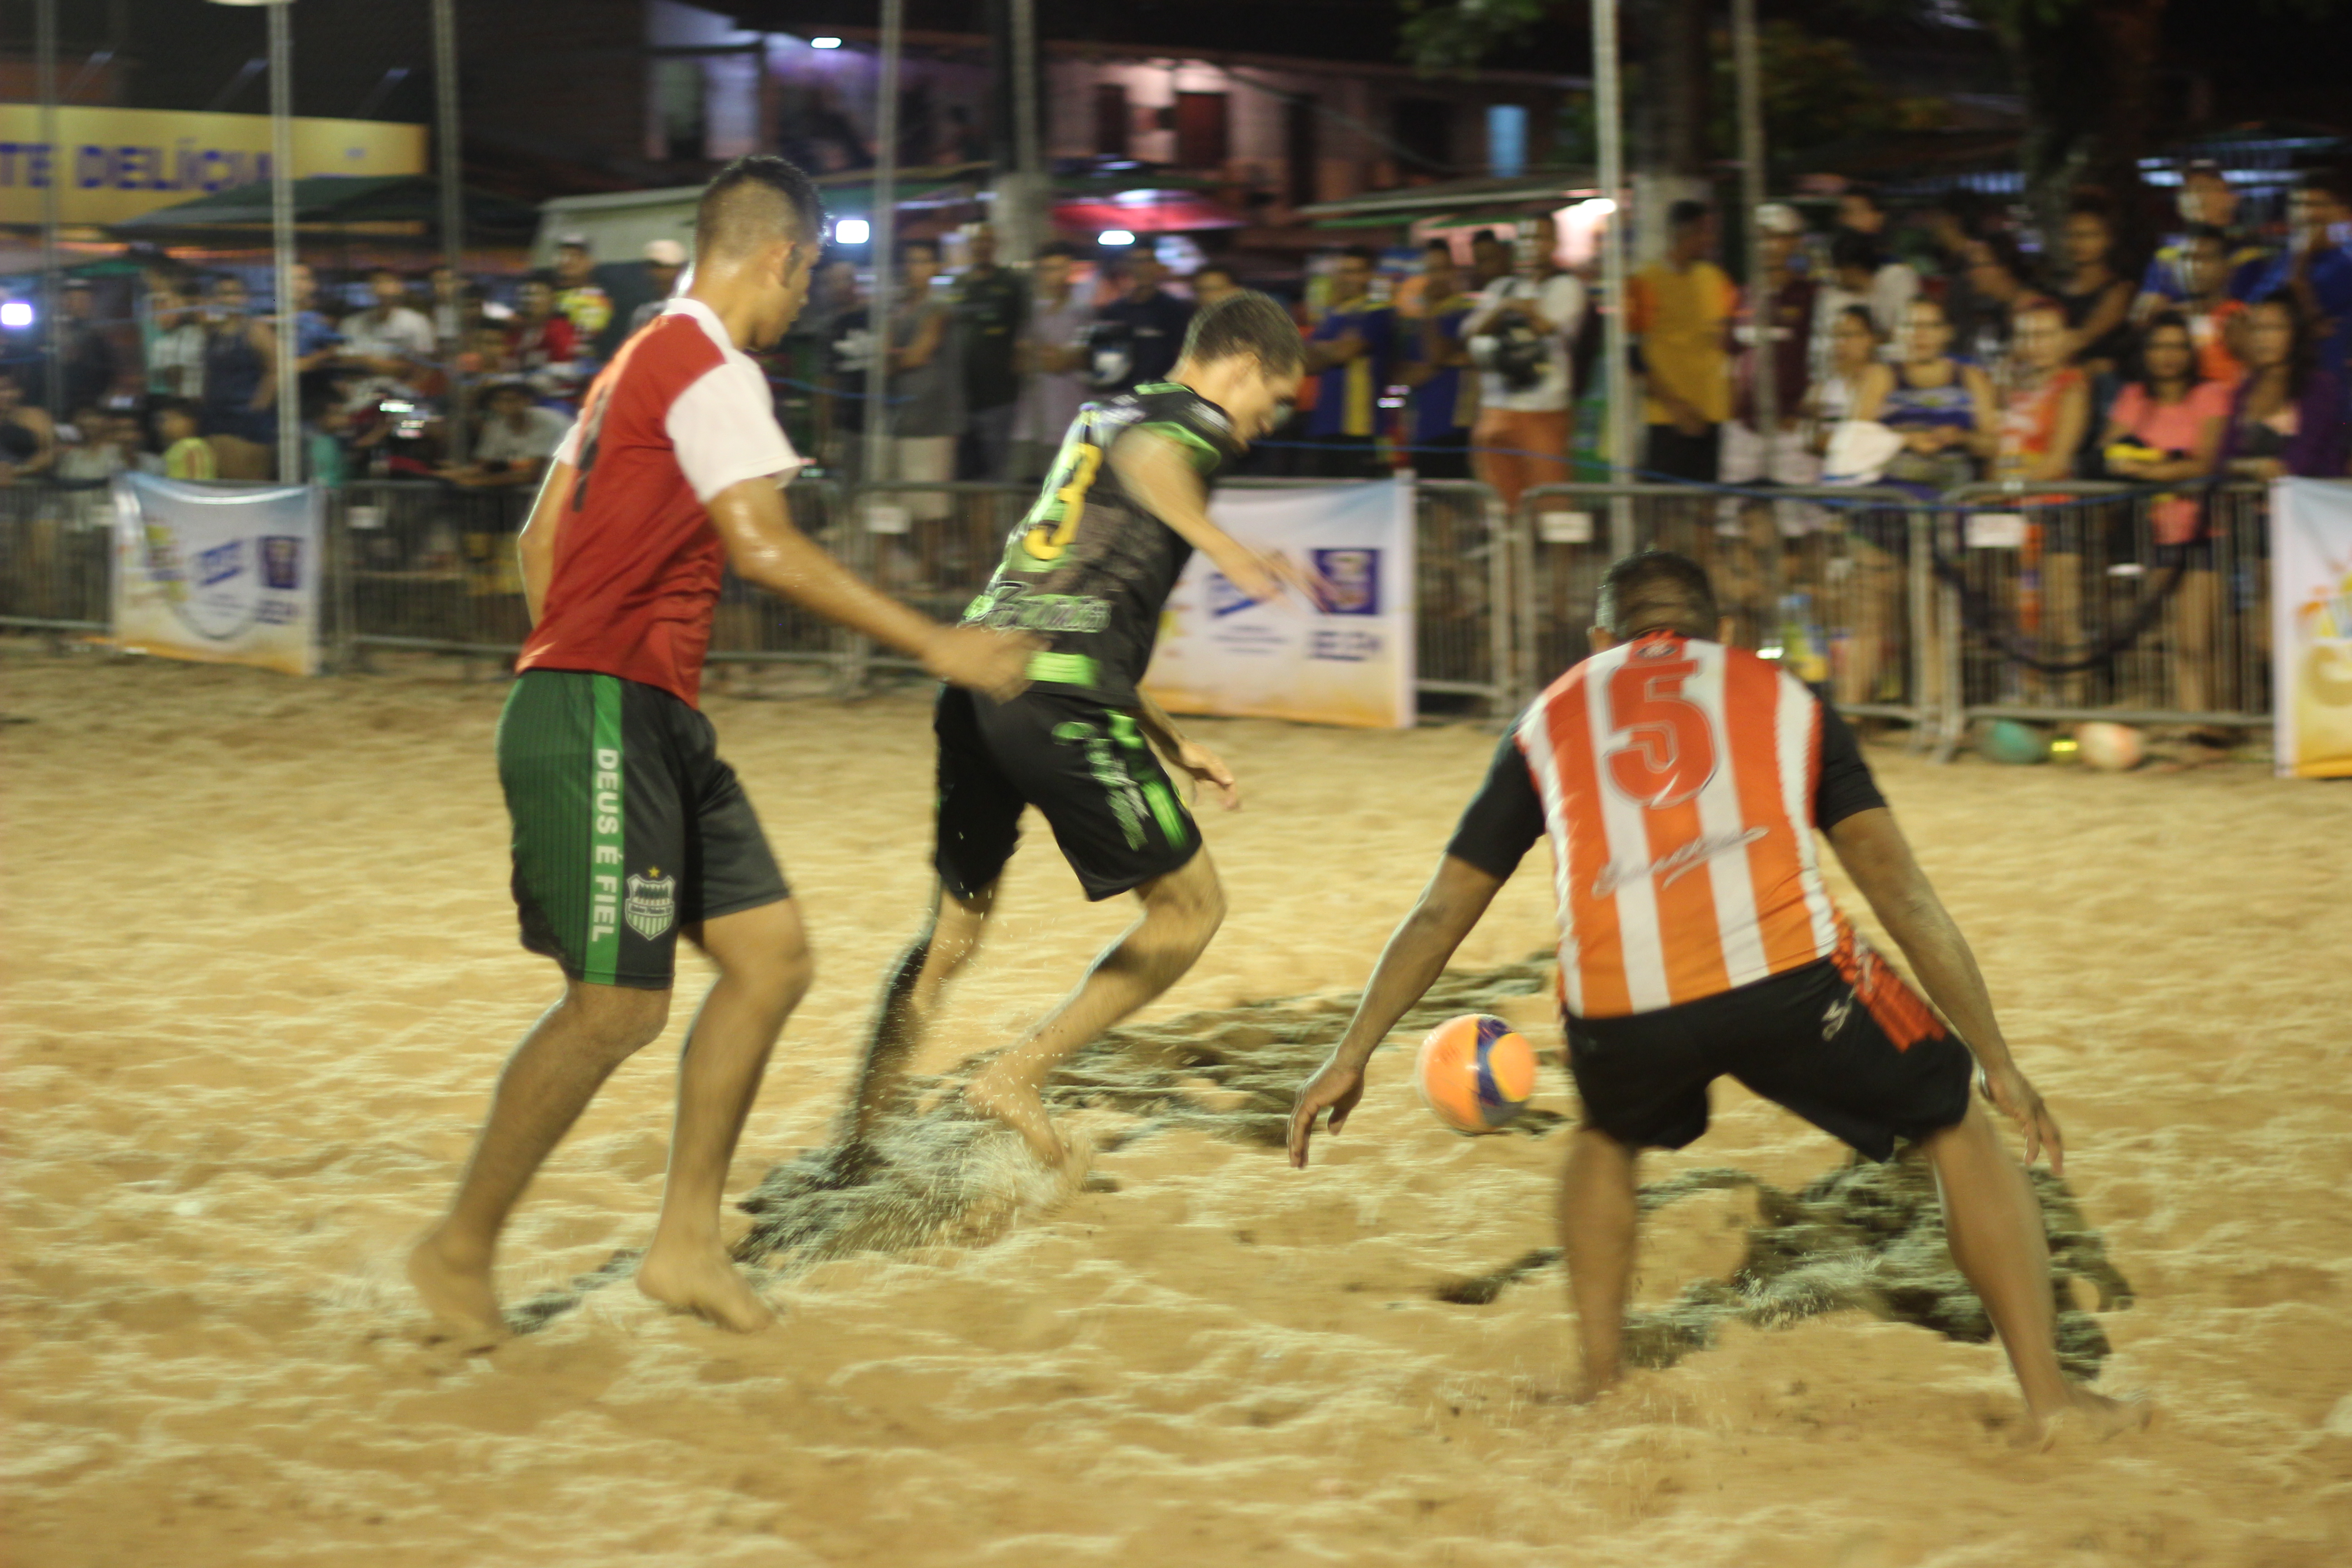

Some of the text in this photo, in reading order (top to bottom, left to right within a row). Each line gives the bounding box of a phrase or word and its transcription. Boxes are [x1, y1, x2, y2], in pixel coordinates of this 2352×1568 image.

[1604, 658, 1720, 809] 5
[592, 749, 624, 942] DEUS É FIEL
